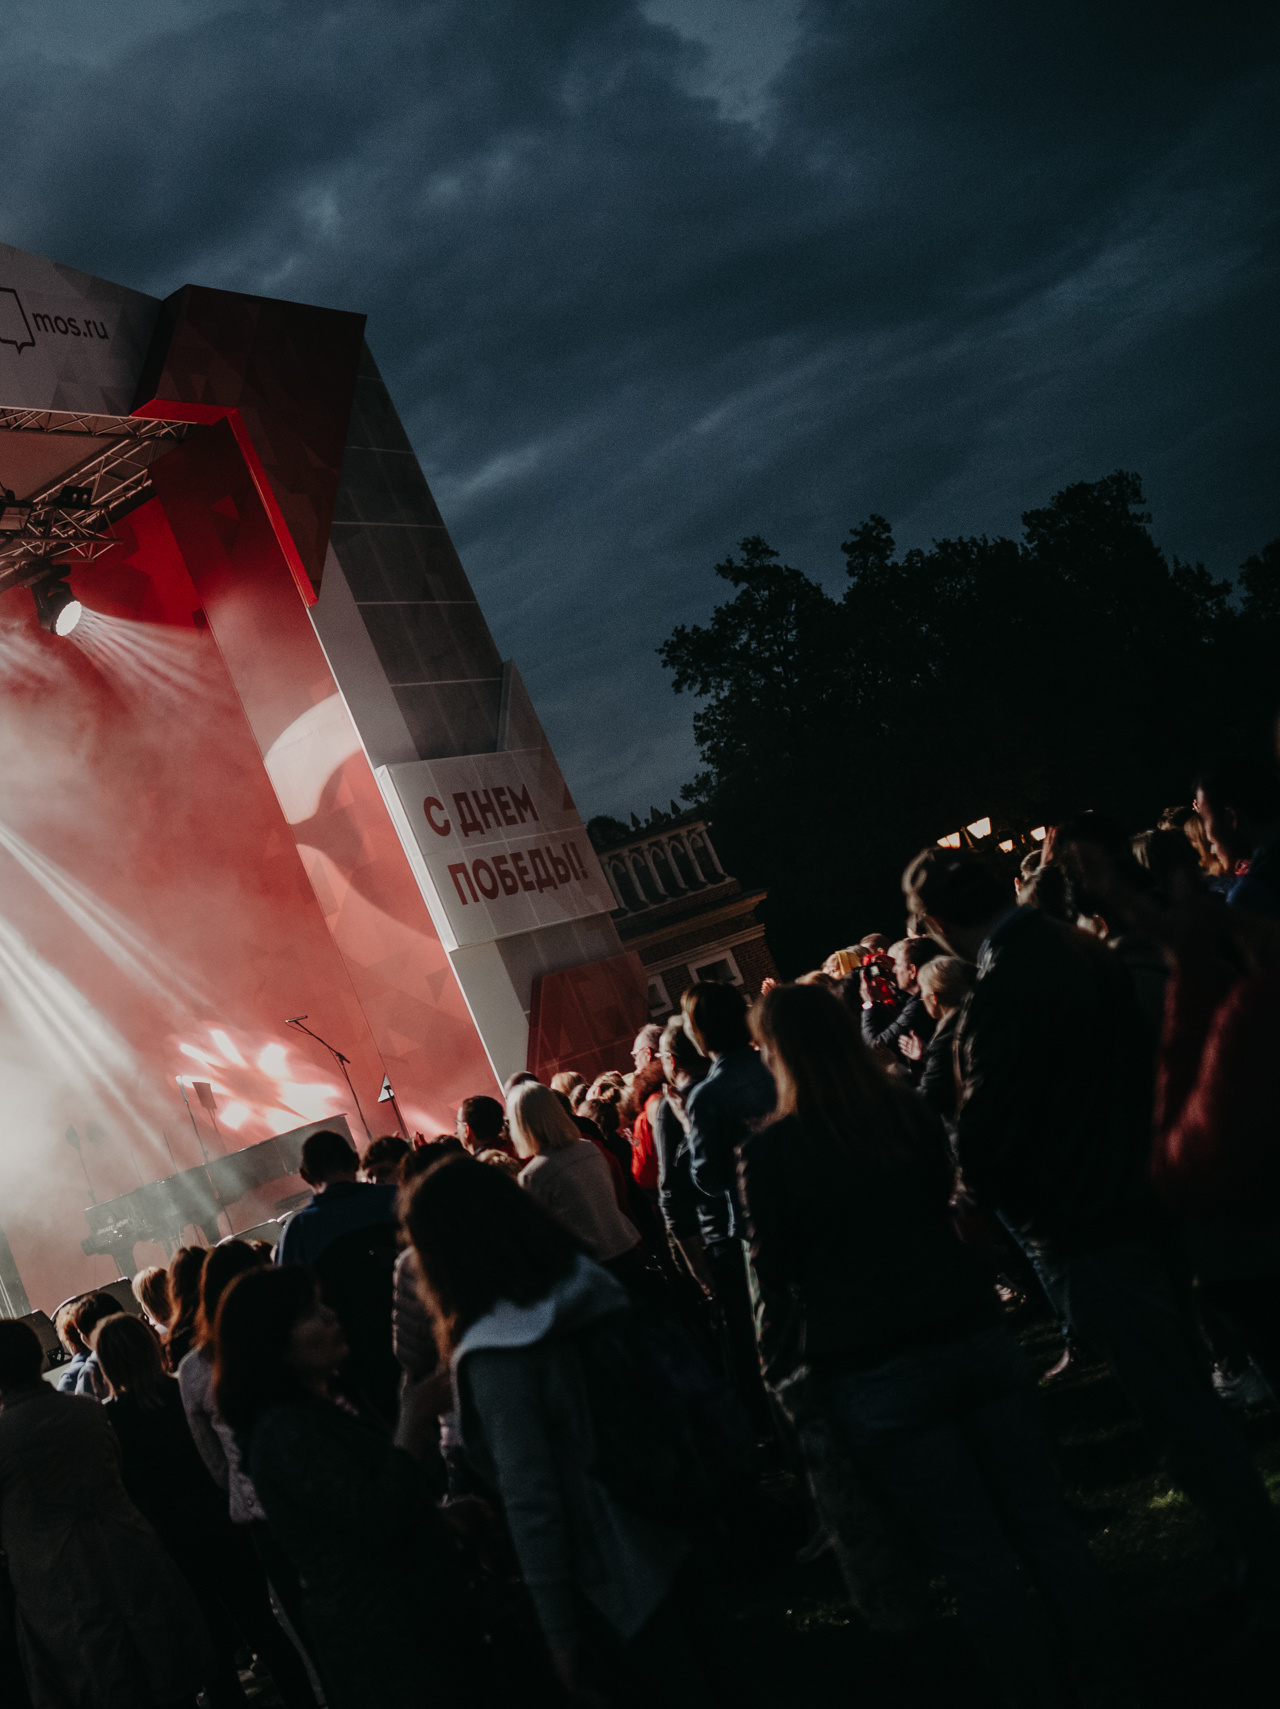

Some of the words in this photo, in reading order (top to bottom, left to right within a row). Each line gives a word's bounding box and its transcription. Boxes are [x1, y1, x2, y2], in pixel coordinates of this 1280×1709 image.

[31, 312, 109, 340] mos.ru
[423, 796, 451, 837] С
[452, 783, 539, 837] ДНЕМ
[447, 841, 589, 906] ПОБЕДЫ!
